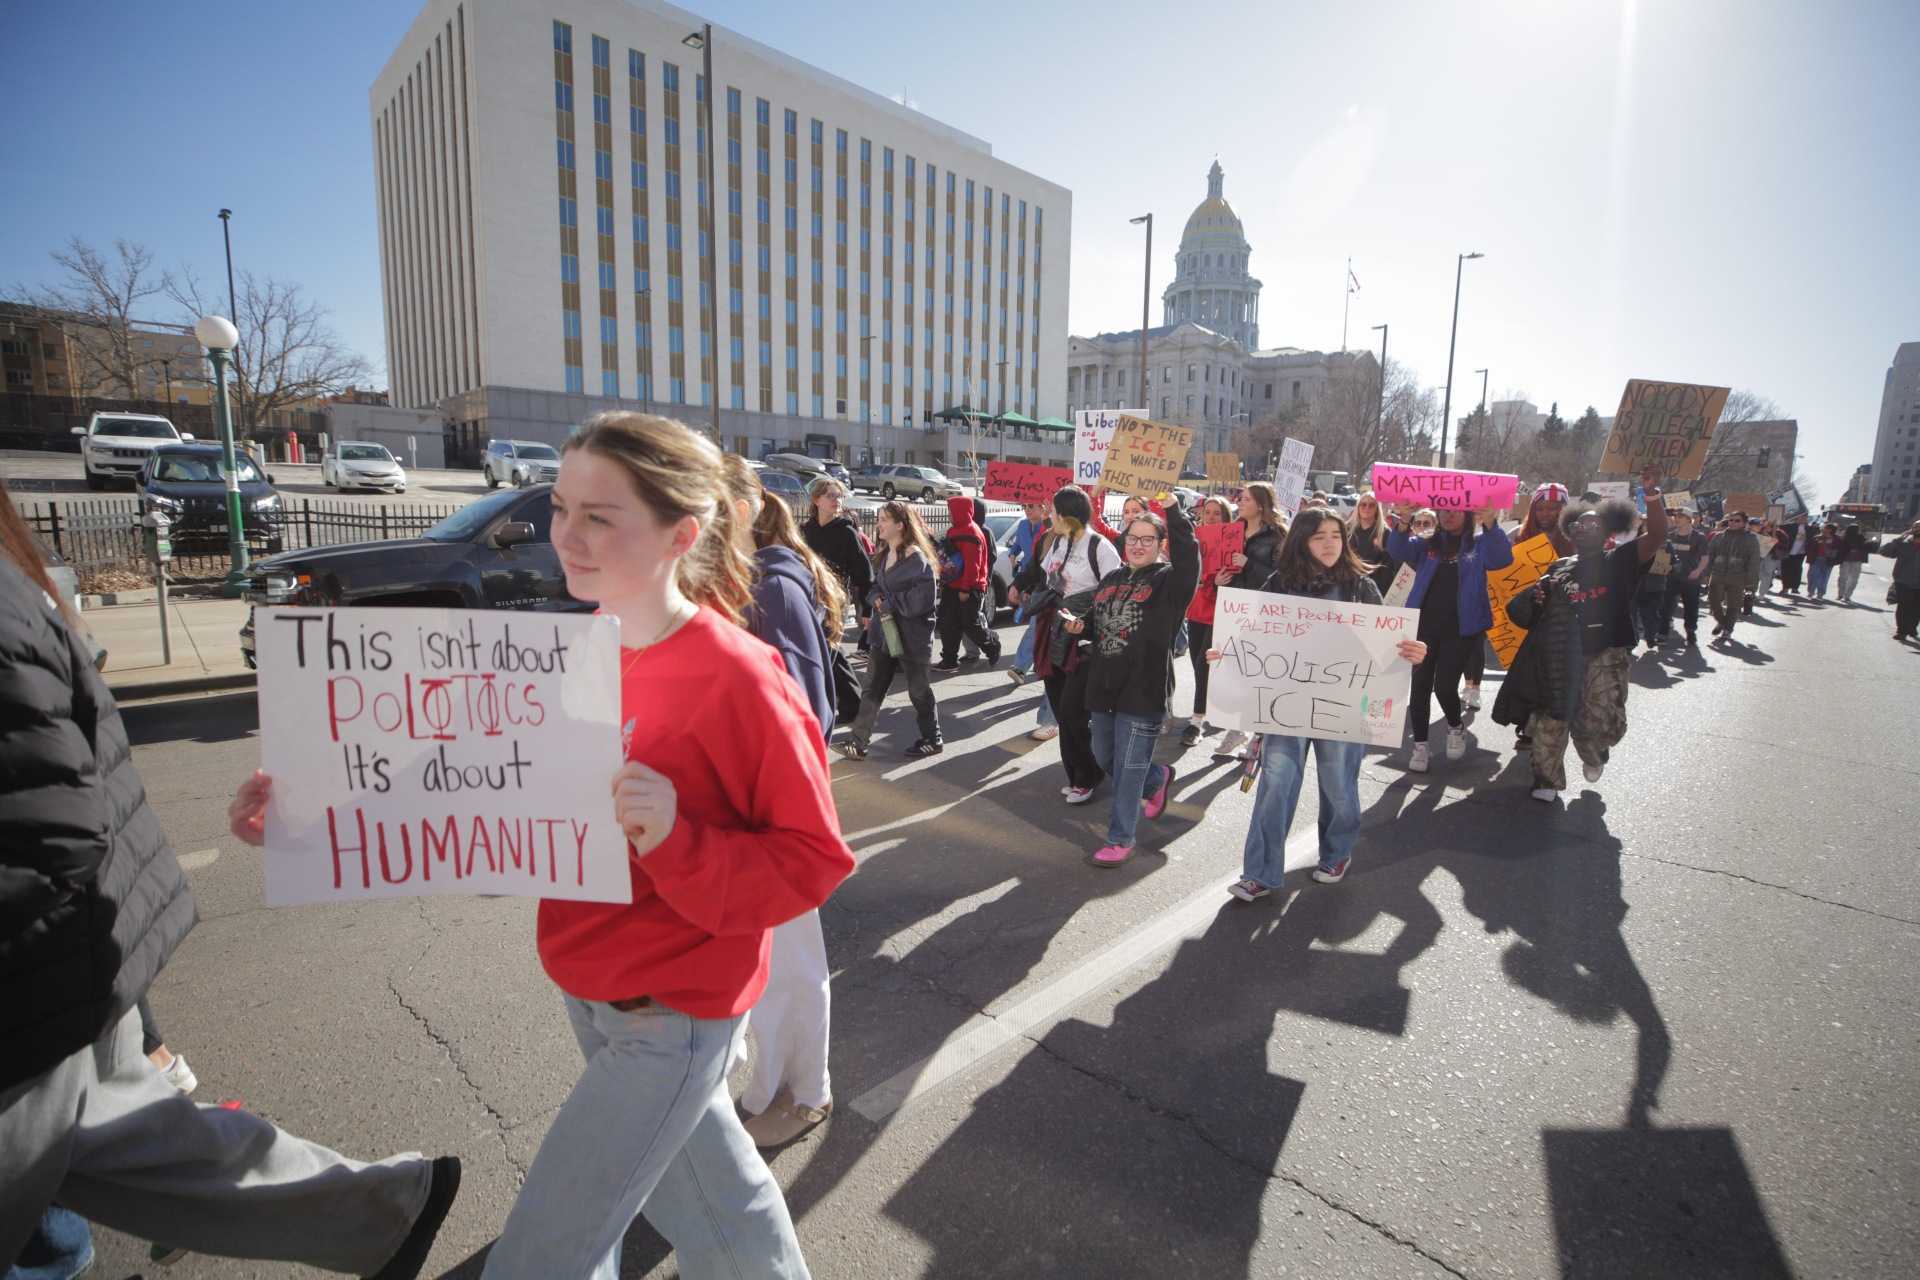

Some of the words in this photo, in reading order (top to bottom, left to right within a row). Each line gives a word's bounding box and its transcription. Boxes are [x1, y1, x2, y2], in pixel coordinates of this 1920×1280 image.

[1624, 383, 1718, 417] NOBODY
[1085, 412, 1119, 428] Liber
[1117, 416, 1154, 436] NOT
[1159, 427, 1190, 446] THE
[1616, 410, 1634, 431] IS
[1639, 411, 1712, 440] ILLEGAL
[1089, 439, 1110, 452] Jus
[1129, 436, 1167, 457] ICE
[1608, 433, 1633, 457] ON
[1634, 435, 1693, 459] STOLEN
[1079, 461, 1101, 478] FOR
[1110, 448, 1121, 461] I
[1130, 454, 1177, 472] WANTED
[1104, 469, 1134, 487] THIS
[1377, 474, 1465, 493] MATTER
[1475, 475, 1499, 487] TO
[1223, 600, 1249, 614] WE
[1259, 602, 1291, 617] ARE
[1375, 616, 1410, 632] NOT
[274, 613, 393, 671] This
[418, 619, 481, 671] isn't
[491, 624, 568, 673] about
[1217, 636, 1376, 688] ABOLISH
[344, 743, 391, 793] It's
[423, 741, 532, 792] about
[326, 806, 588, 889] HUMANITY
